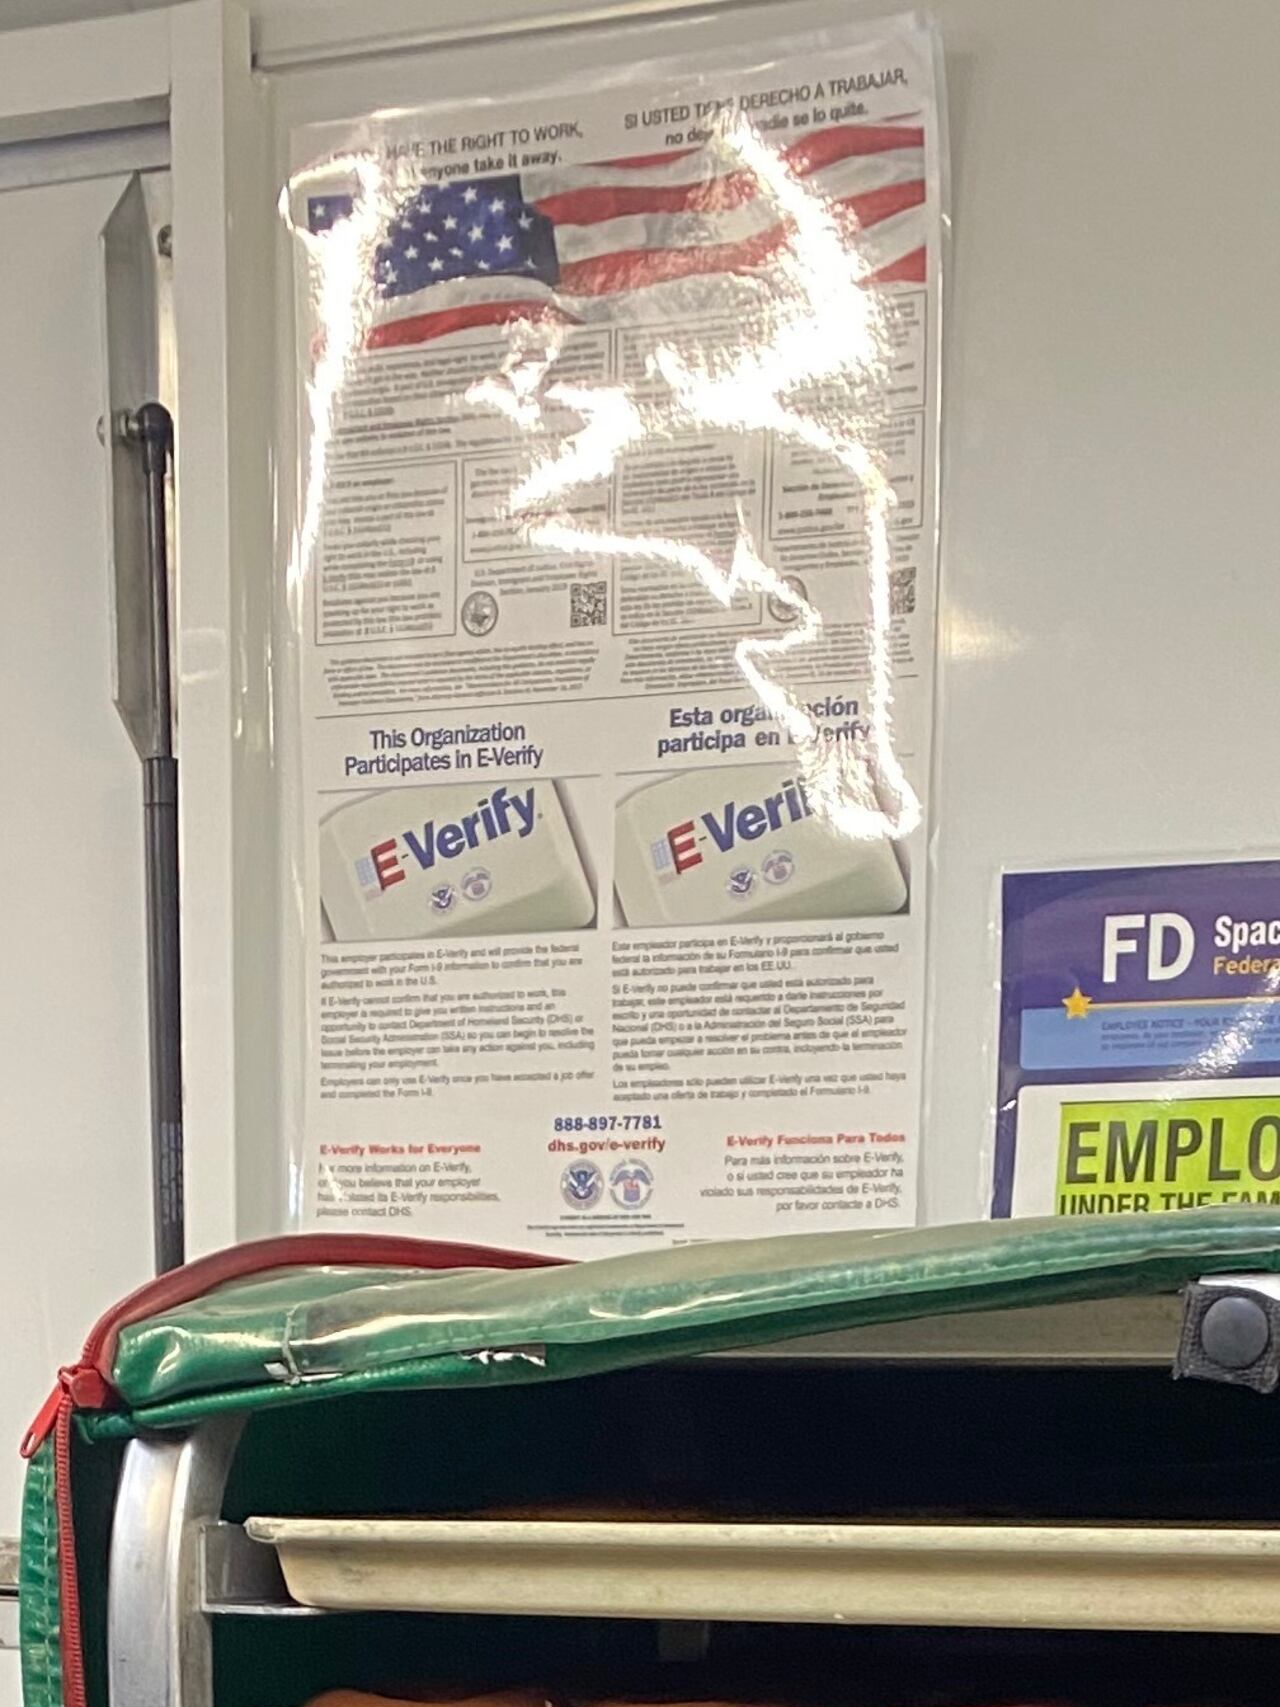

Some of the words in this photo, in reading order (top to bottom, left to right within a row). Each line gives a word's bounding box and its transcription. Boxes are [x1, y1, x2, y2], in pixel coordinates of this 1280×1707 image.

[624, 113, 638, 130] SI
[643, 104, 689, 127] USTED
[740, 84, 811, 110] DERECHO
[814, 83, 825, 99] A
[828, 68, 908, 94] TRABAJAR,
[430, 138, 457, 156] THE
[461, 132, 505, 152] RIGHT
[511, 129, 530, 145] TO
[534, 121, 583, 143] WORK,
[666, 133, 682, 146] no
[793, 113, 809, 126] se
[830, 102, 868, 122] quite.
[475, 158, 502, 172] take
[508, 155, 517, 169] it
[522, 151, 562, 168] away.
[670, 708, 713, 728] Esta
[721, 695, 859, 726] orgación
[370, 729, 406, 749] This
[411, 722, 525, 749] Organization
[657, 730, 745, 757] participa
[755, 730, 780, 747] en
[345, 753, 451, 777] Participates
[456, 749, 471, 769] in
[478, 744, 544, 769] E-Verify
[370, 786, 534, 891] E-Verify
[668, 777, 813, 875] E-Veri
[1102, 912, 1195, 984] FD
[554, 1114, 662, 1131] 888-897-7781
[321, 1145, 366, 1157] E-Verify
[369, 1144, 405, 1155] Works
[408, 1144, 423, 1154] for
[428, 1143, 481, 1156] Everyone
[548, 1136, 666, 1154] dhs.gov/e-verify
[727, 1136, 773, 1147] E-Verify
[778, 1135, 833, 1145] Funciona
[837, 1133, 865, 1143] Para
[869, 1133, 905, 1142] Todos
